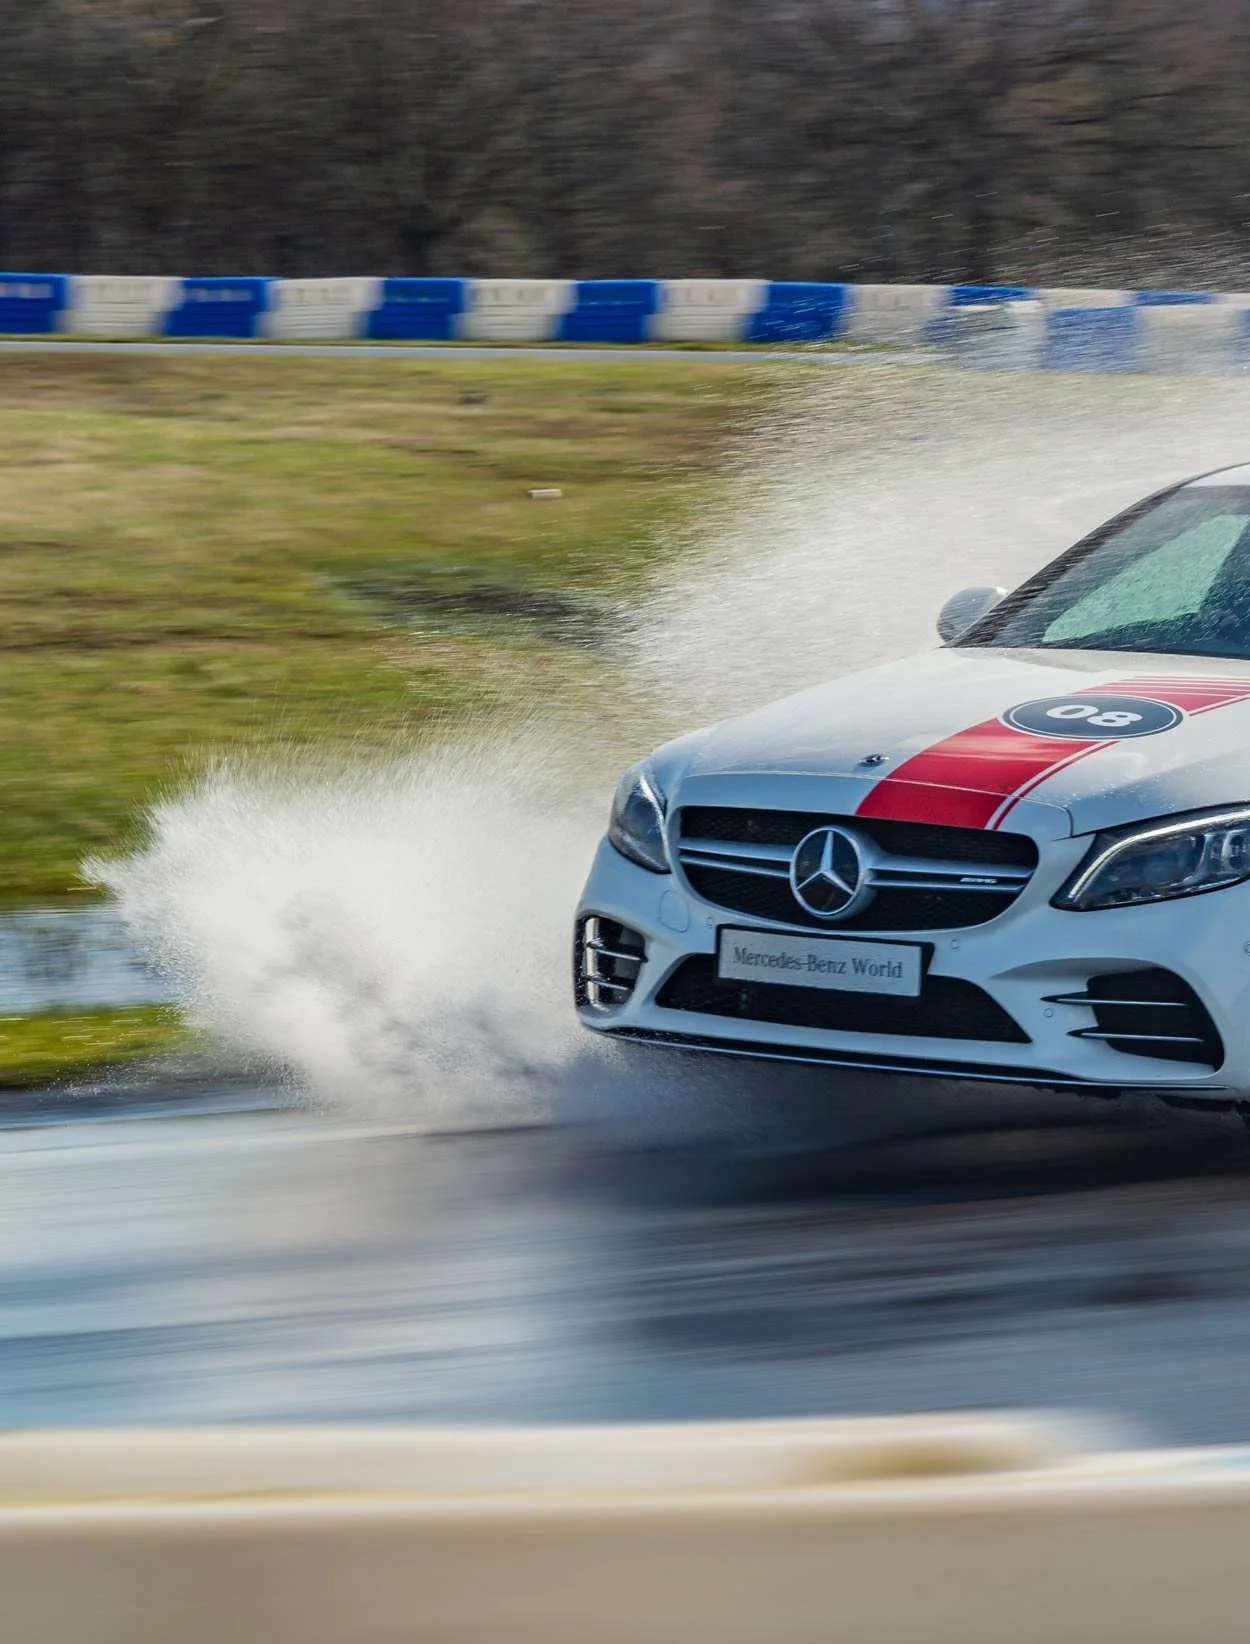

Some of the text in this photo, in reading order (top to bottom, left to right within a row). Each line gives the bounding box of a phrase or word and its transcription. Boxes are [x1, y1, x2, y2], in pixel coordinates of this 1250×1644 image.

[1046, 704, 1143, 727] 08
[732, 946, 904, 979] Mercedes-Benz World
